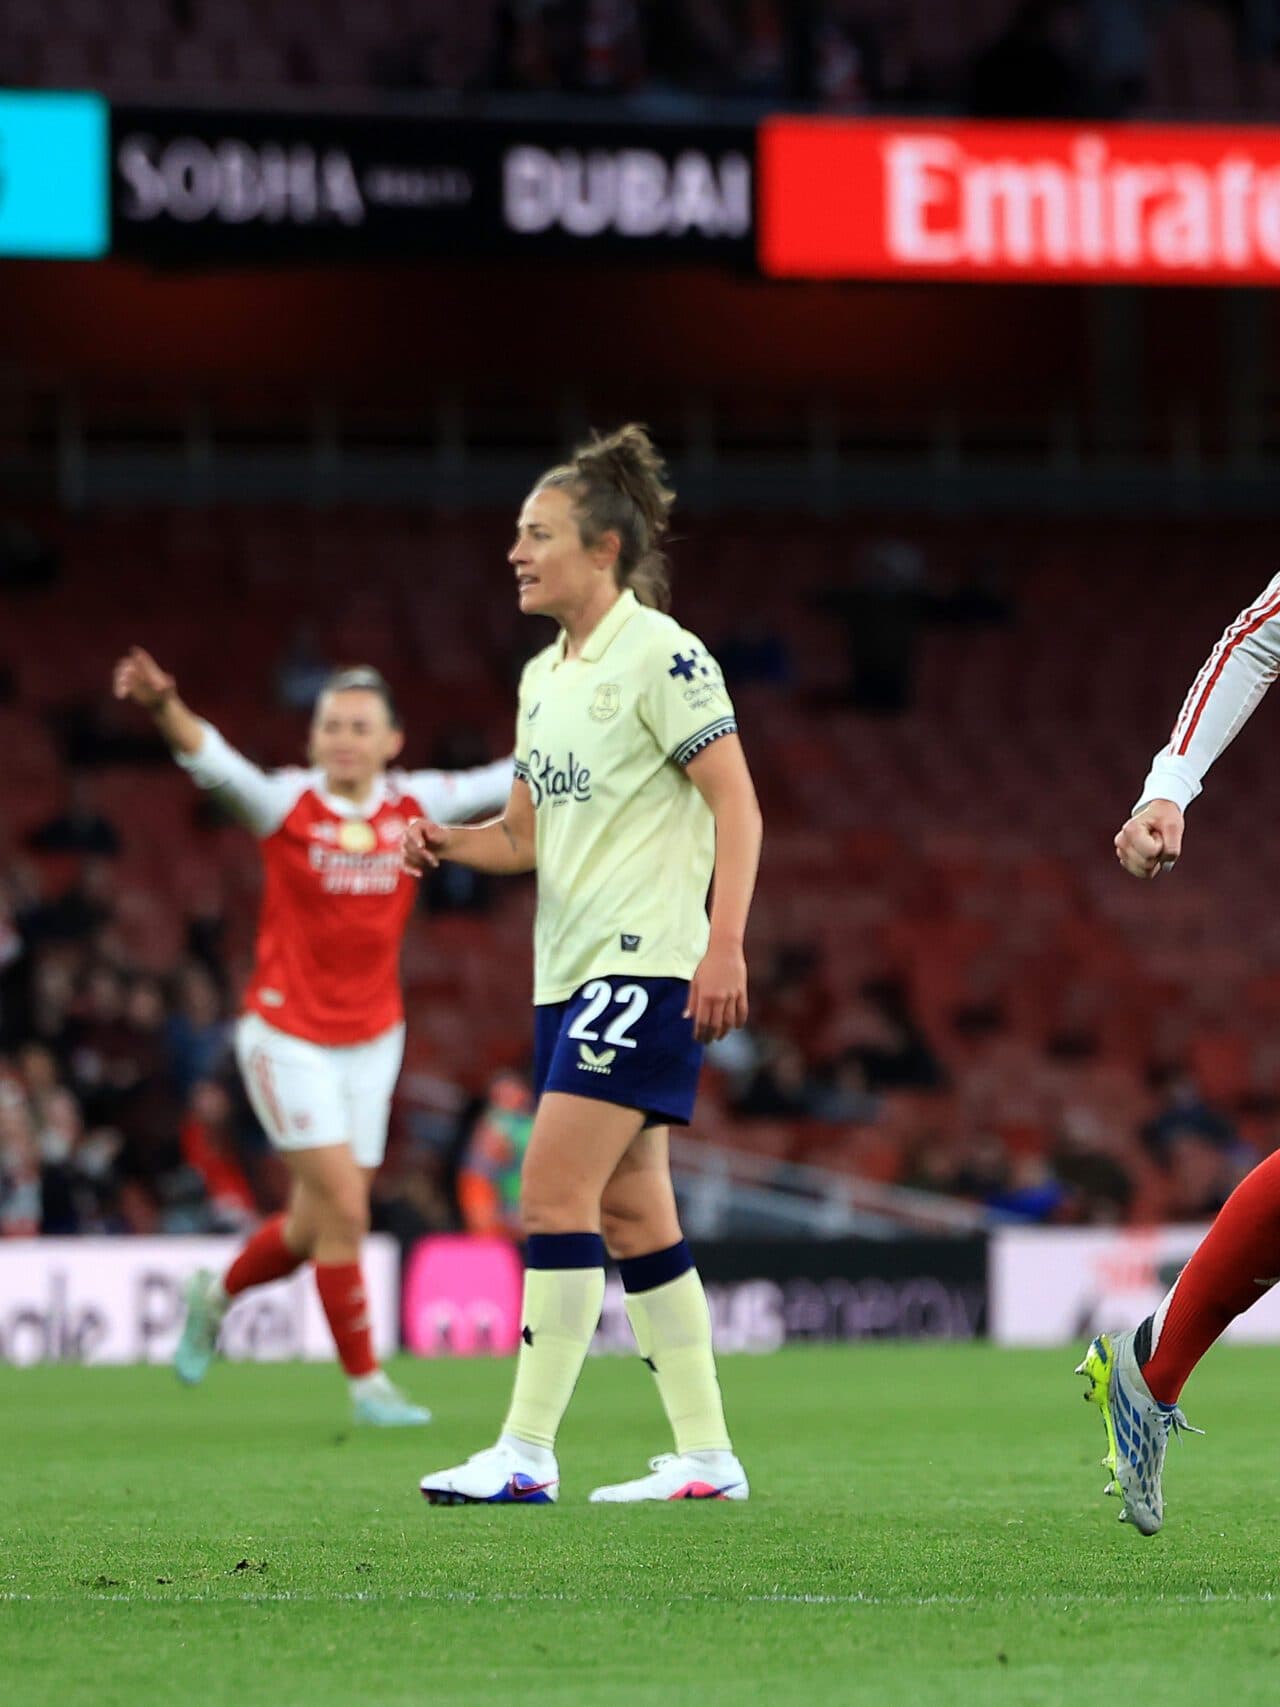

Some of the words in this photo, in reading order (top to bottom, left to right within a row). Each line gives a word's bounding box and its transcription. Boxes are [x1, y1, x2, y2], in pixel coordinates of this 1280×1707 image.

[117, 135, 364, 226] SOBHA
[503, 145, 752, 238] DUBAI
[529, 749, 592, 809] Stake
[568, 980, 649, 1049] 22
